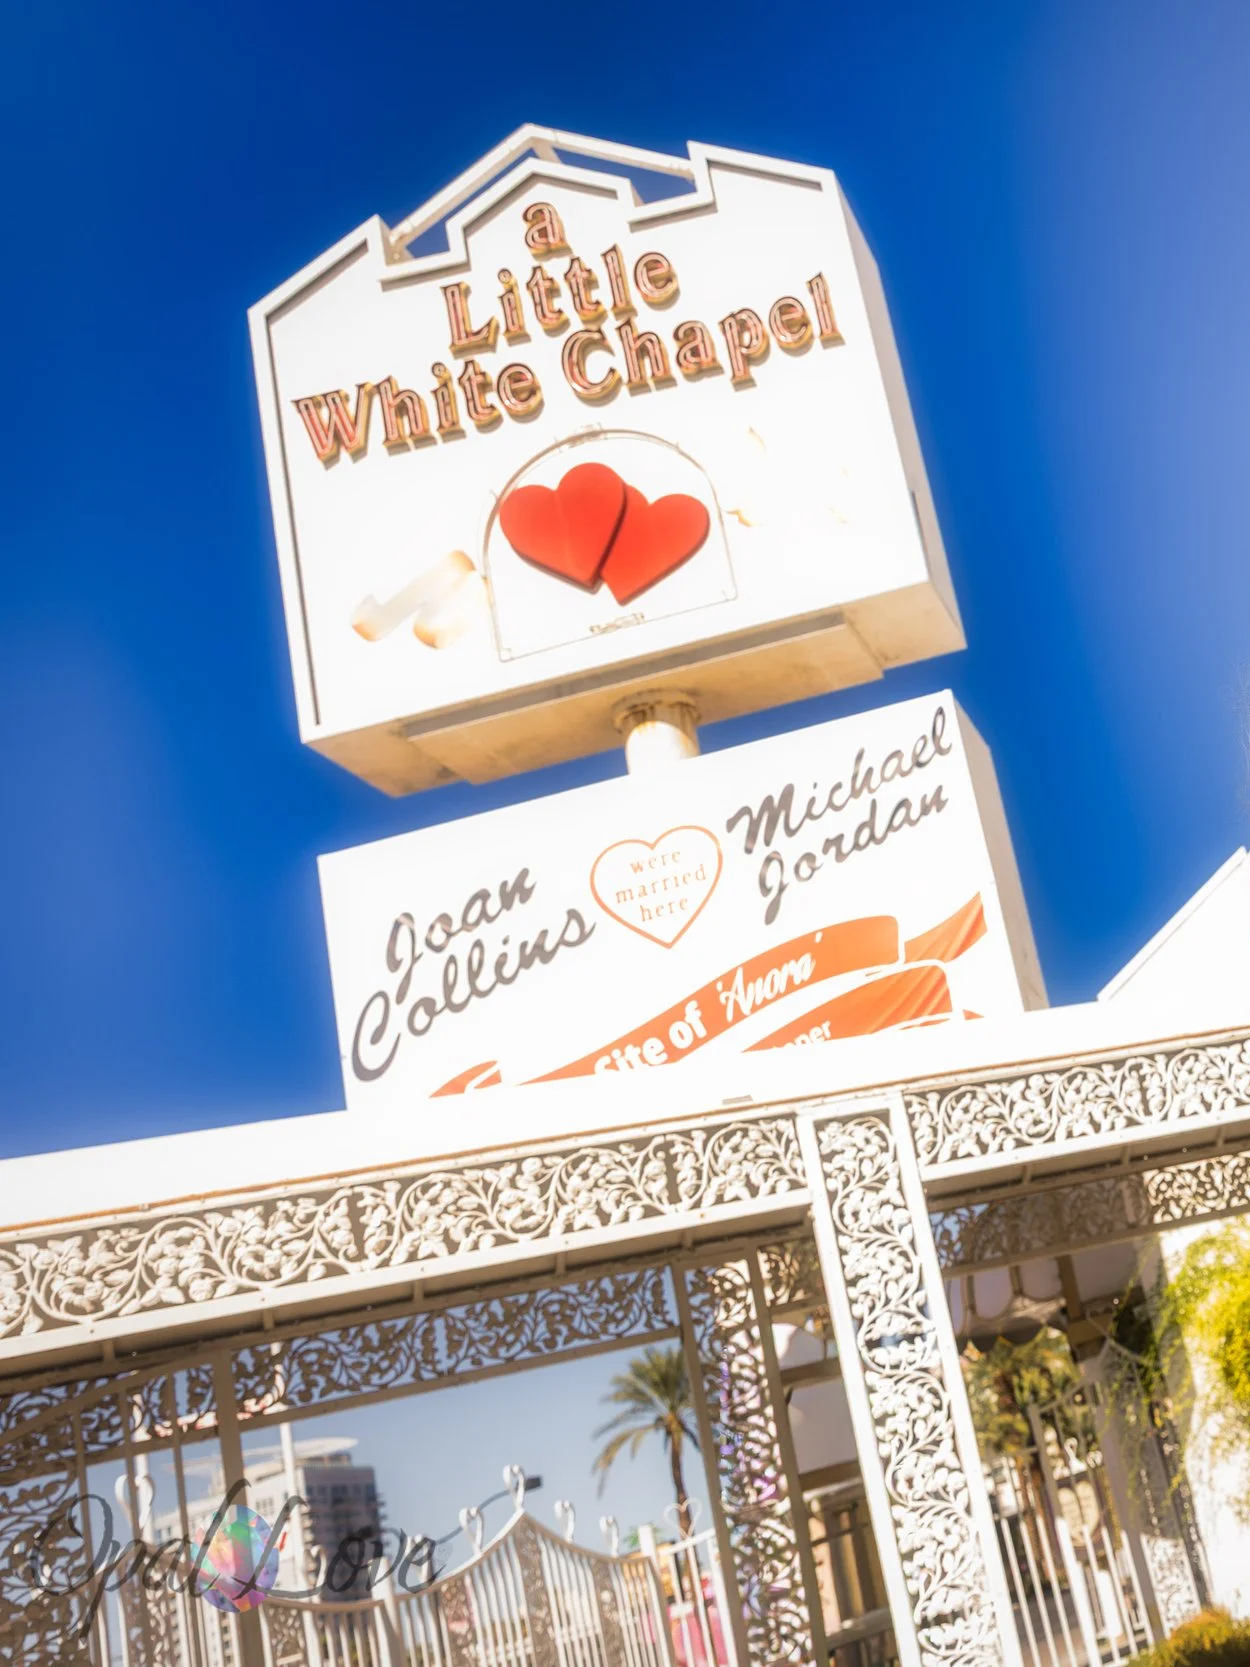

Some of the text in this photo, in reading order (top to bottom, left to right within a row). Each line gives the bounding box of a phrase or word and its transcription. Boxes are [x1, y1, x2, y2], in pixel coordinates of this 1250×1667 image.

[521, 202, 569, 255] a
[440, 244, 682, 356] Little
[293, 272, 845, 469] White Chapel
[726, 706, 953, 855] Michael
[615, 863, 706, 905] married
[629, 850, 681, 875] were
[639, 898, 689, 923] here
[758, 785, 949, 926] Jordan
[386, 867, 537, 1006] Joan
[351, 908, 597, 1082] Collins
[668, 999, 707, 1049] of
